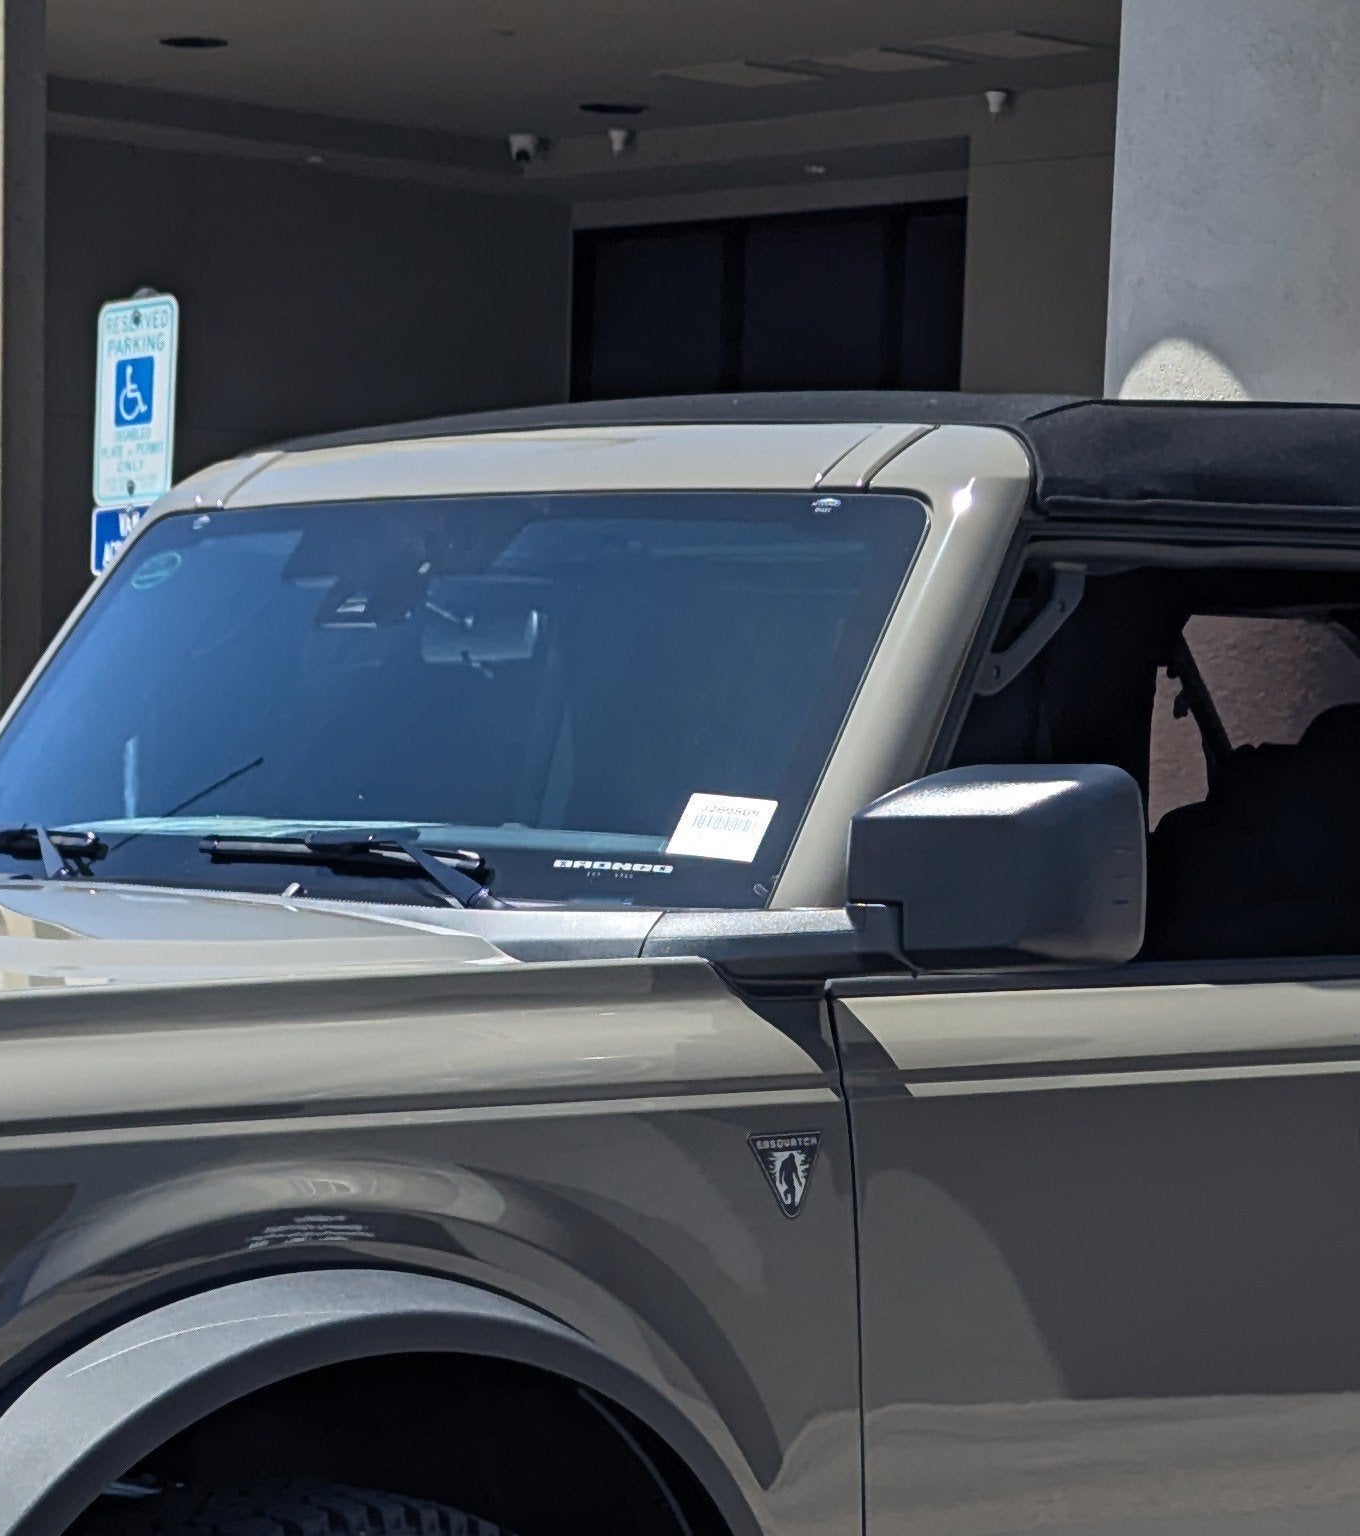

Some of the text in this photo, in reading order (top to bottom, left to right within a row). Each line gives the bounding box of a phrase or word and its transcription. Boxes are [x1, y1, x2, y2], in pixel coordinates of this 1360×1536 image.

[105, 309, 170, 332] RESVED
[107, 332, 167, 356] PARKING
[553, 860, 674, 873] BRONCO
